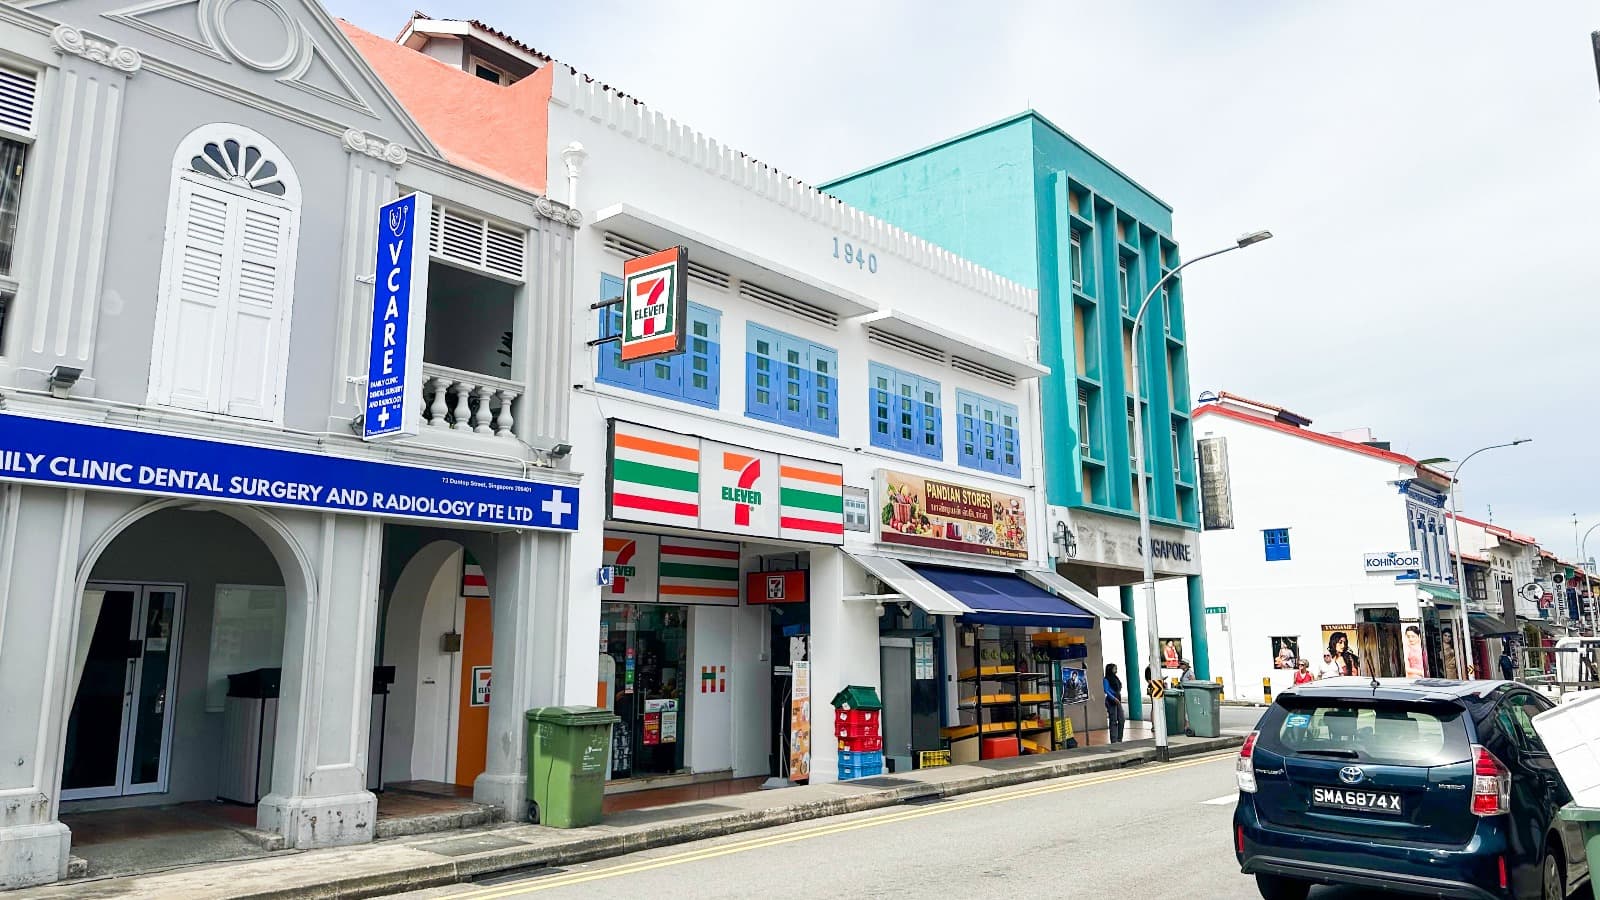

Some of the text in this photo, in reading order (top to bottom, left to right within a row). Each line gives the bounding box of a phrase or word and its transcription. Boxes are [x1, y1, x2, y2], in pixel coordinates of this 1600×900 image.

[833, 237, 877, 273] 1940
[383, 240, 403, 375] VCARE
[636, 277, 664, 335] 7
[49, 456, 133, 483] CLINIC
[138, 466, 223, 492] DENTAL
[228, 476, 323, 502] SURGERY
[326, 487, 368, 507] AND
[372, 492, 475, 518] RADIOLOGY
[478, 503, 504, 520] PTE
[508, 505, 533, 522] LTD
[449, 478, 470, 487] Dunlop
[488, 482, 514, 491] Singapore
[723, 452, 760, 526] 7
[927, 482, 991, 509] PANDIAN STORES
[1366, 557, 1419, 567] KOHINOOR
[701, 665, 726, 693] Hi
